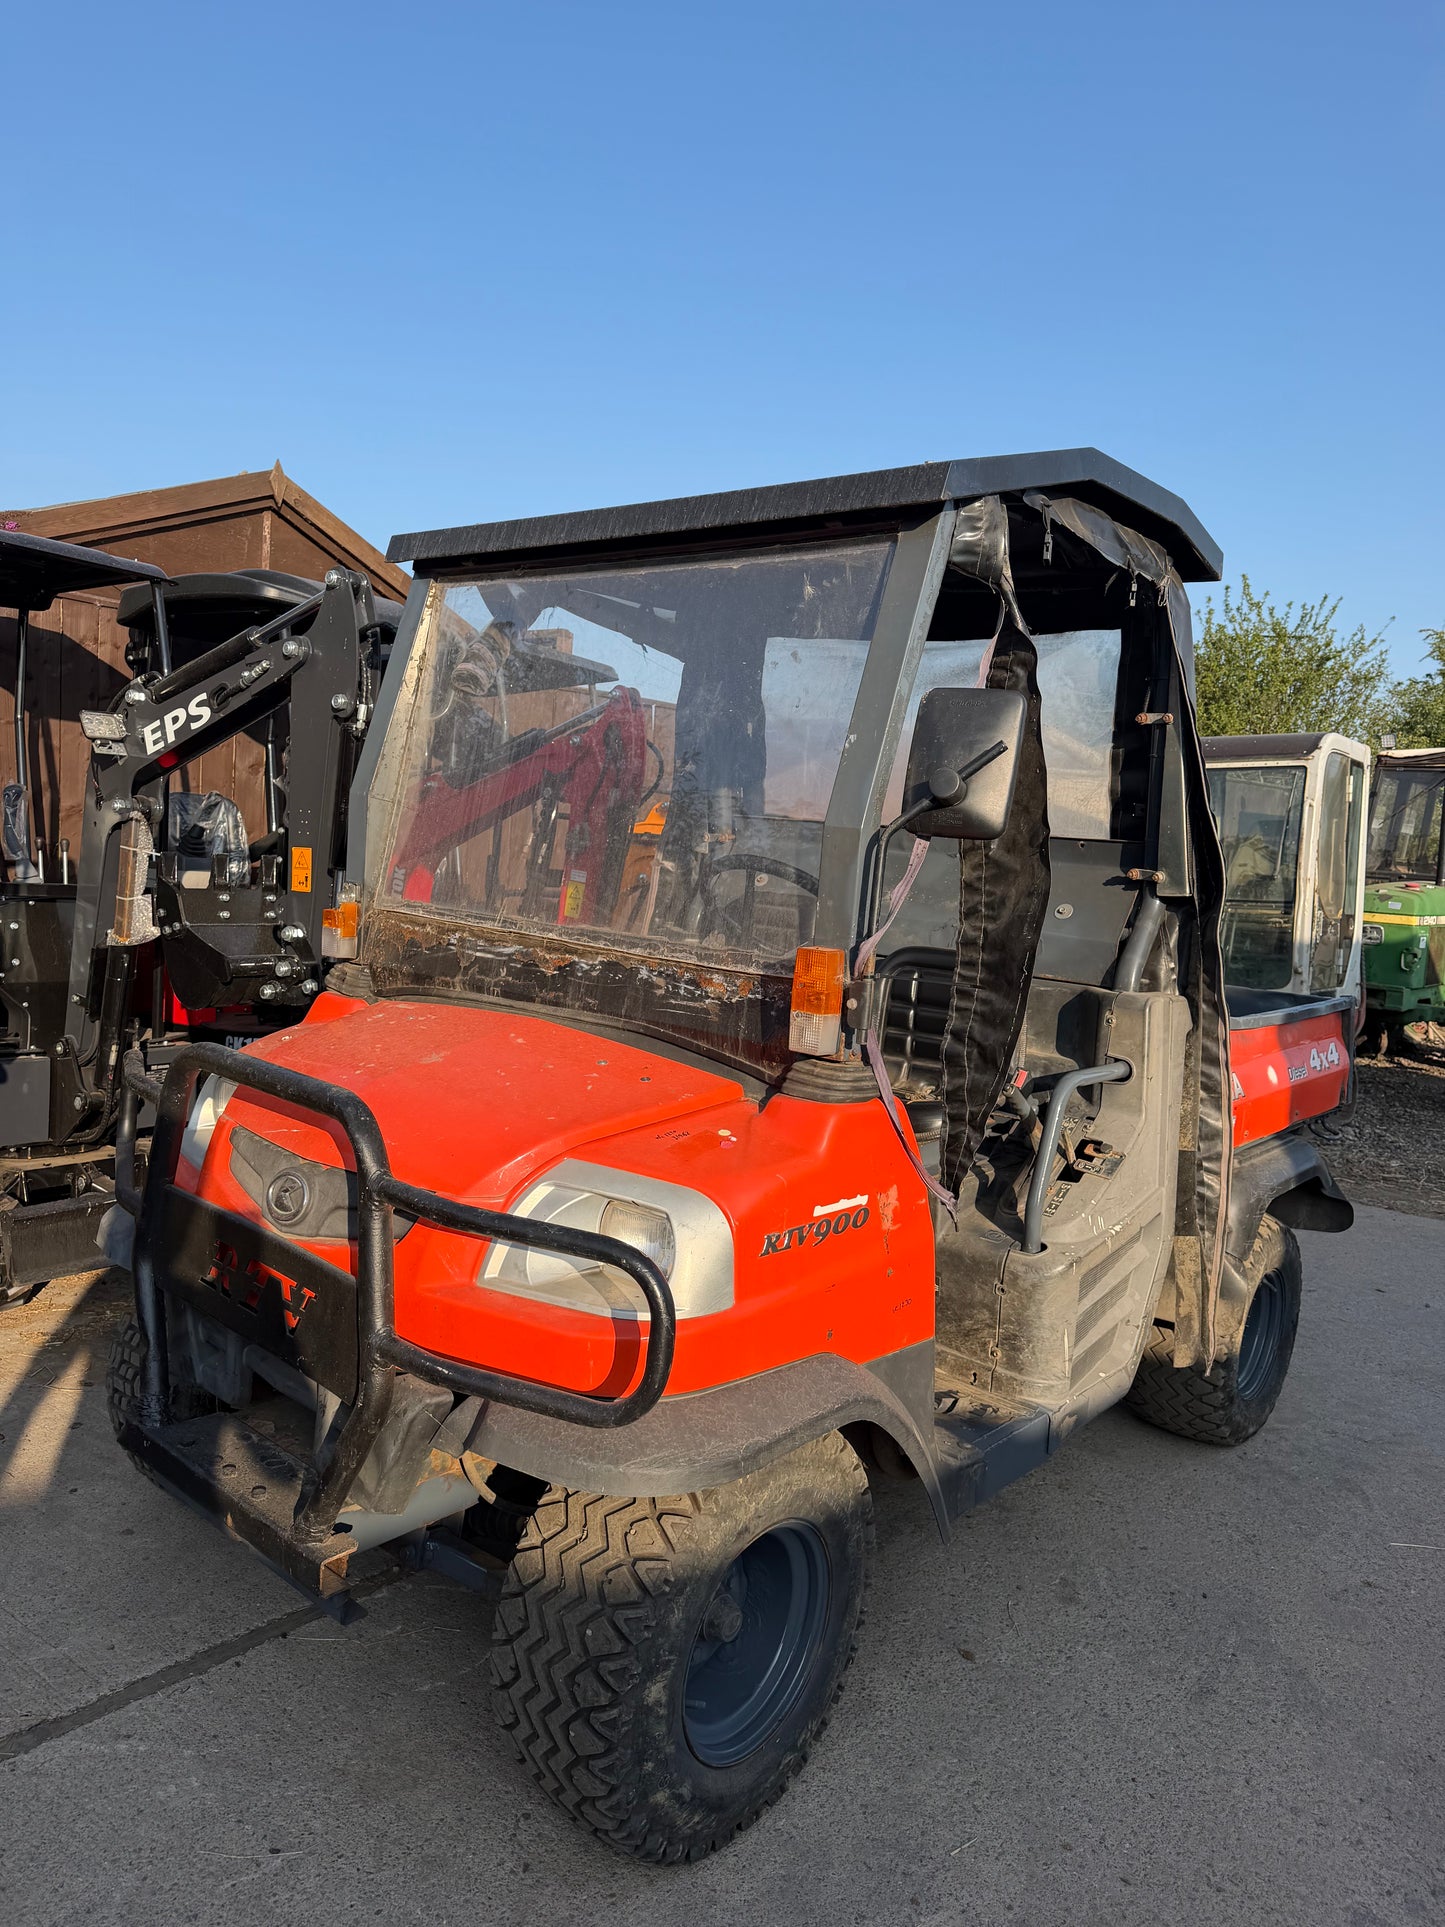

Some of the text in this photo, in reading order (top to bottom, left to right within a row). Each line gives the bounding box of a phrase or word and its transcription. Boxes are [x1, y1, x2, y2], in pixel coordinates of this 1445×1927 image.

[143, 692, 212, 756] EPS
[1288, 1042, 1340, 1082] Diesel 4x4
[758, 1207, 870, 1257] RTV900
[199, 1240, 318, 1338] RTV
